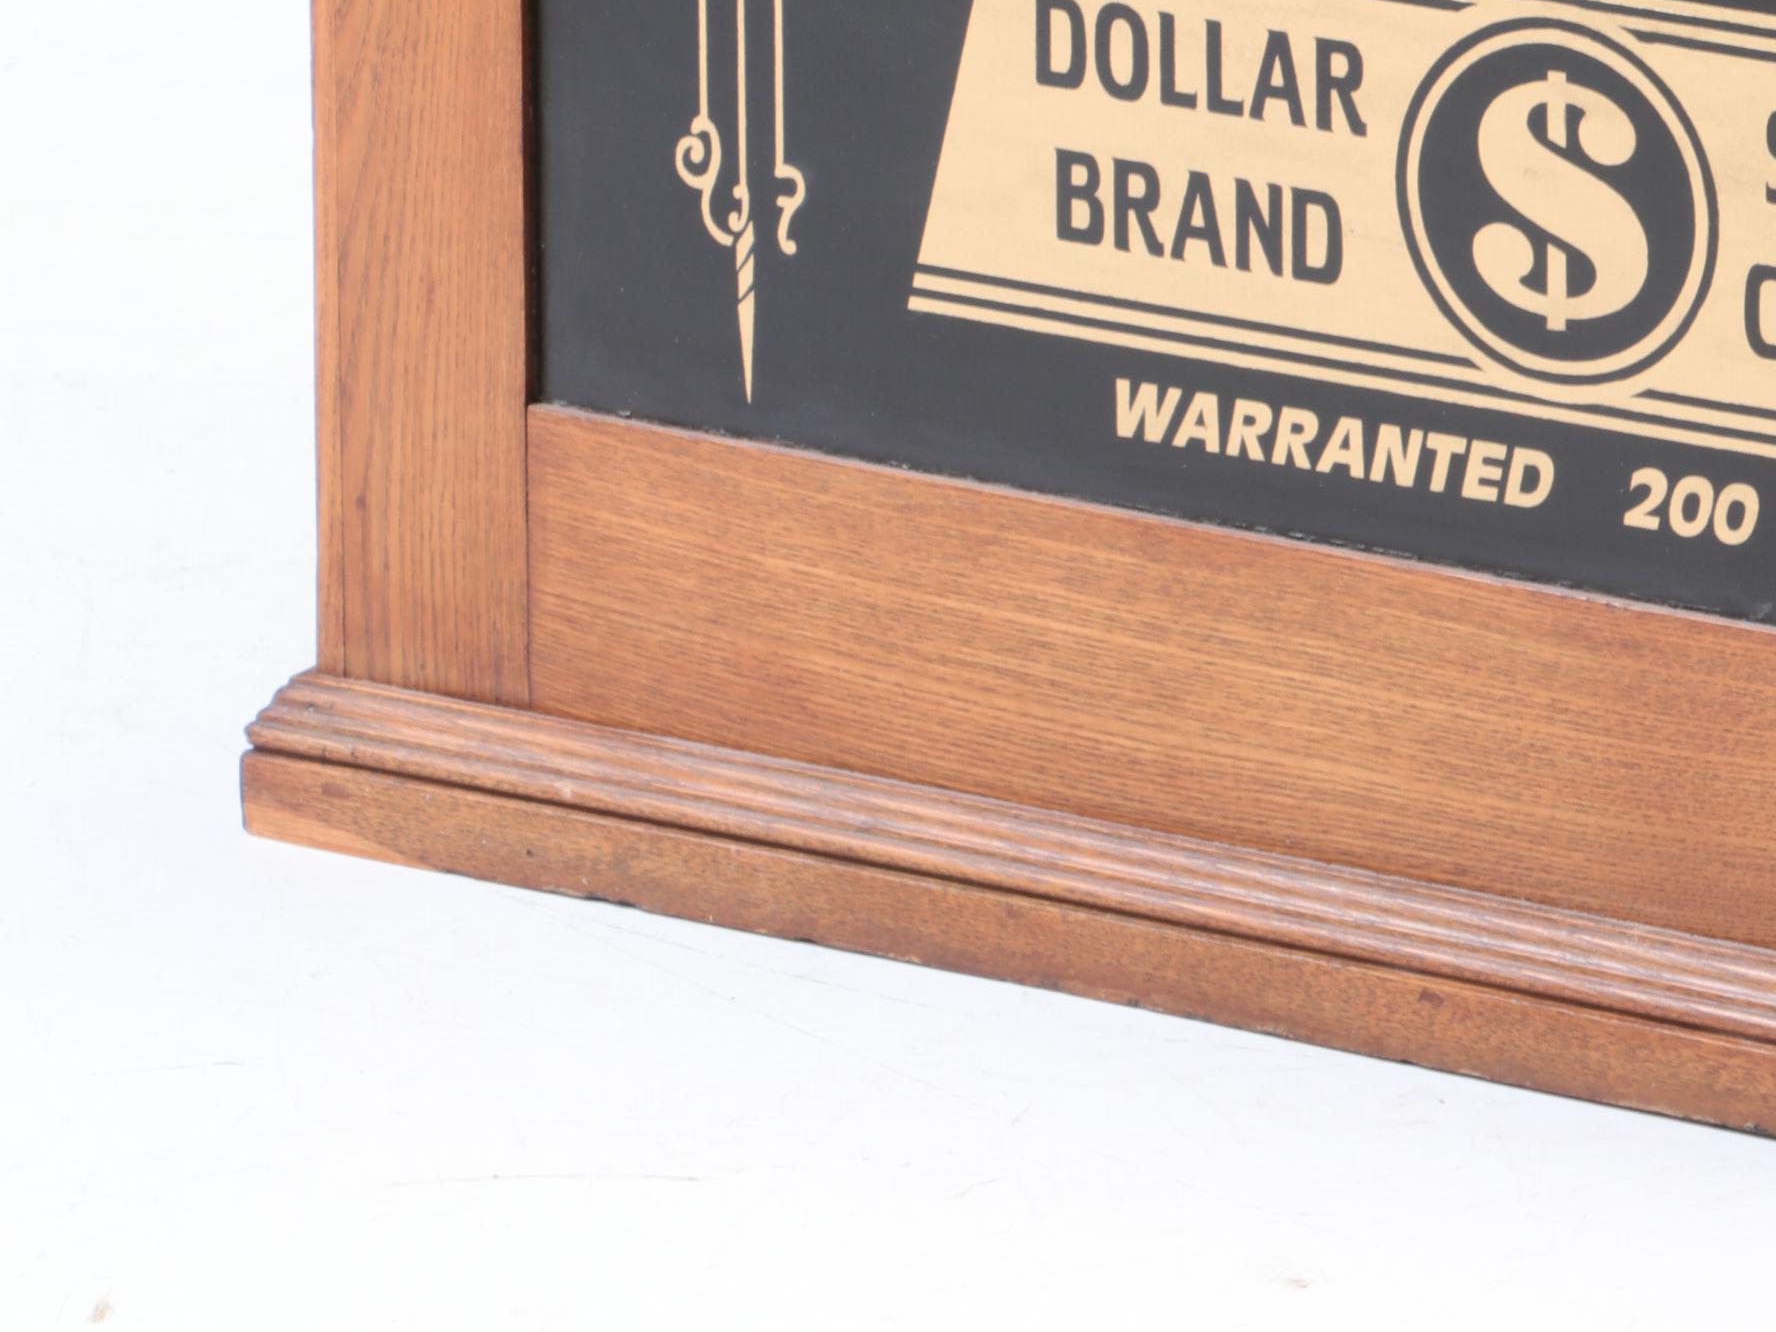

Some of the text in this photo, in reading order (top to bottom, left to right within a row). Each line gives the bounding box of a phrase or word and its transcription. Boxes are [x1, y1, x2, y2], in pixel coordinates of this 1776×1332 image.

[1056, 149, 1342, 284] BRAND
[1471, 68, 1650, 332] $
[1114, 377, 1555, 509] WARRANTED
[1622, 466, 1761, 546] 200
